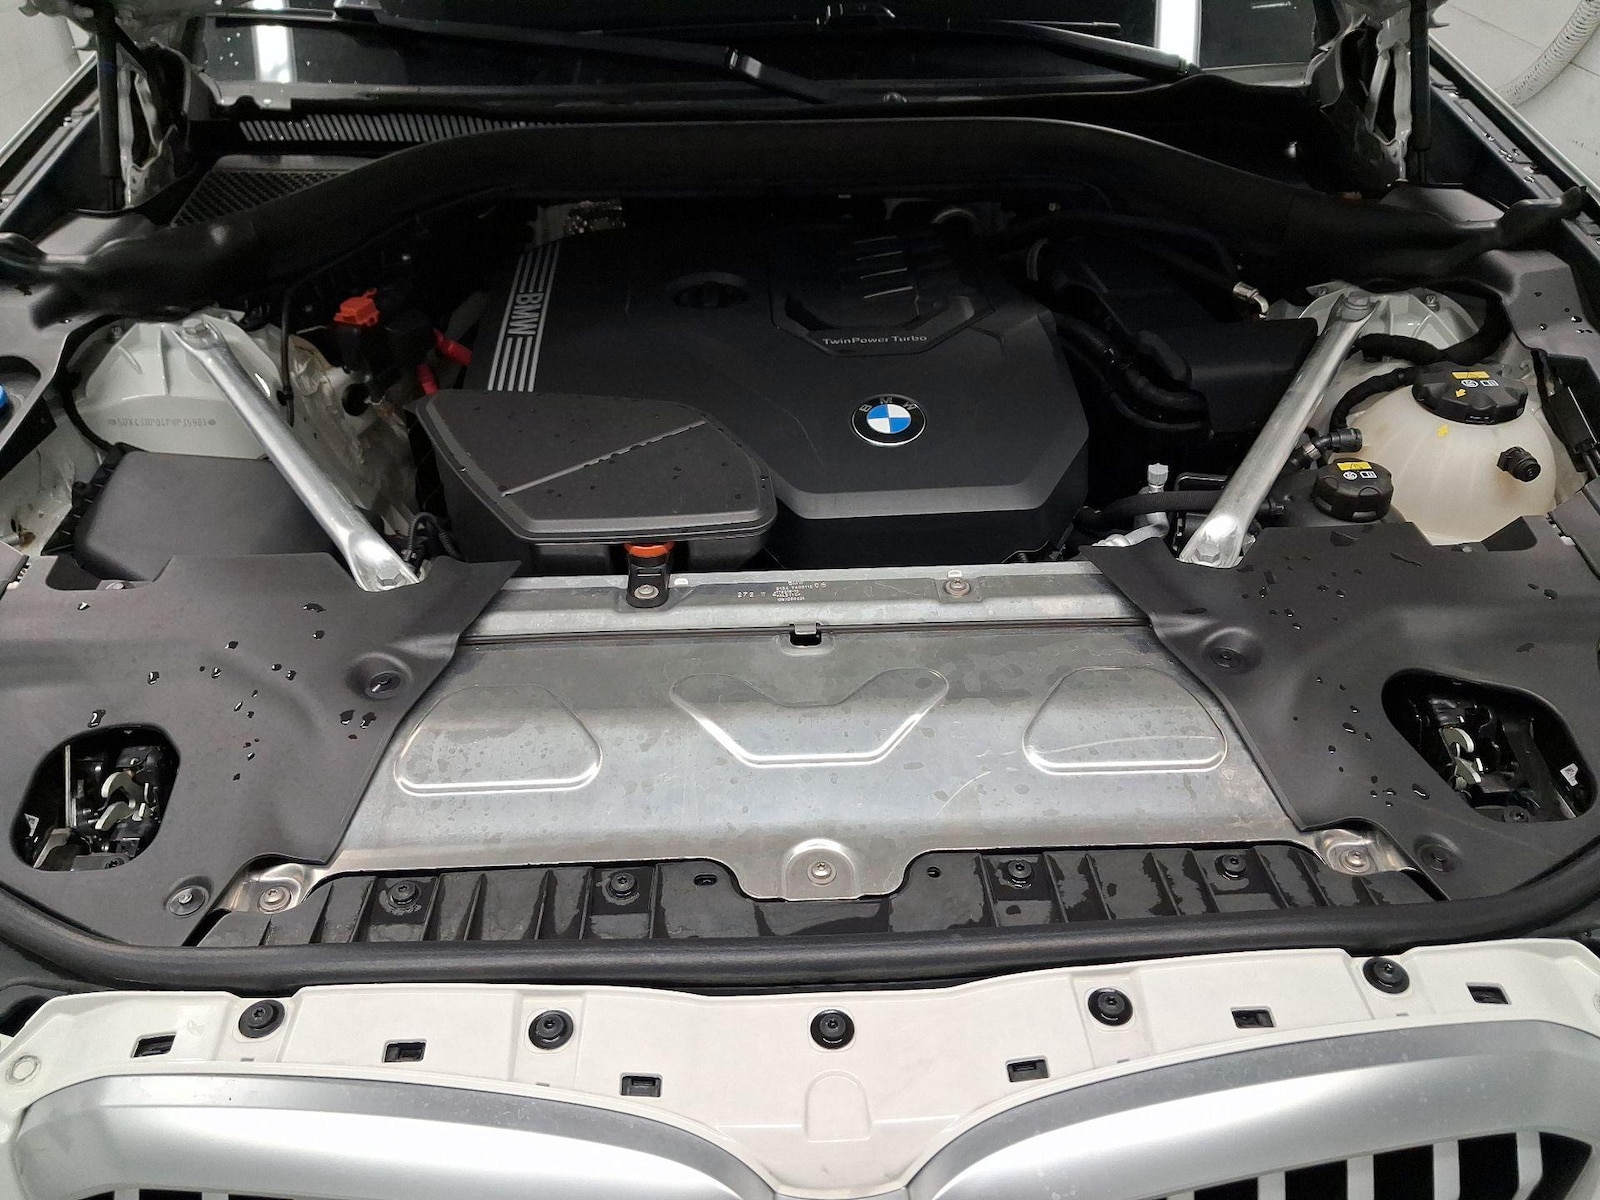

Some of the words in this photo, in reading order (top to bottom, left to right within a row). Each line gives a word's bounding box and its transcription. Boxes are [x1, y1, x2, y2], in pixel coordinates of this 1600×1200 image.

[507, 293, 544, 335] BMW
[822, 337, 889, 345] TwinPower
[890, 335, 927, 343] Turbo
[859, 397, 916, 413] BMW
